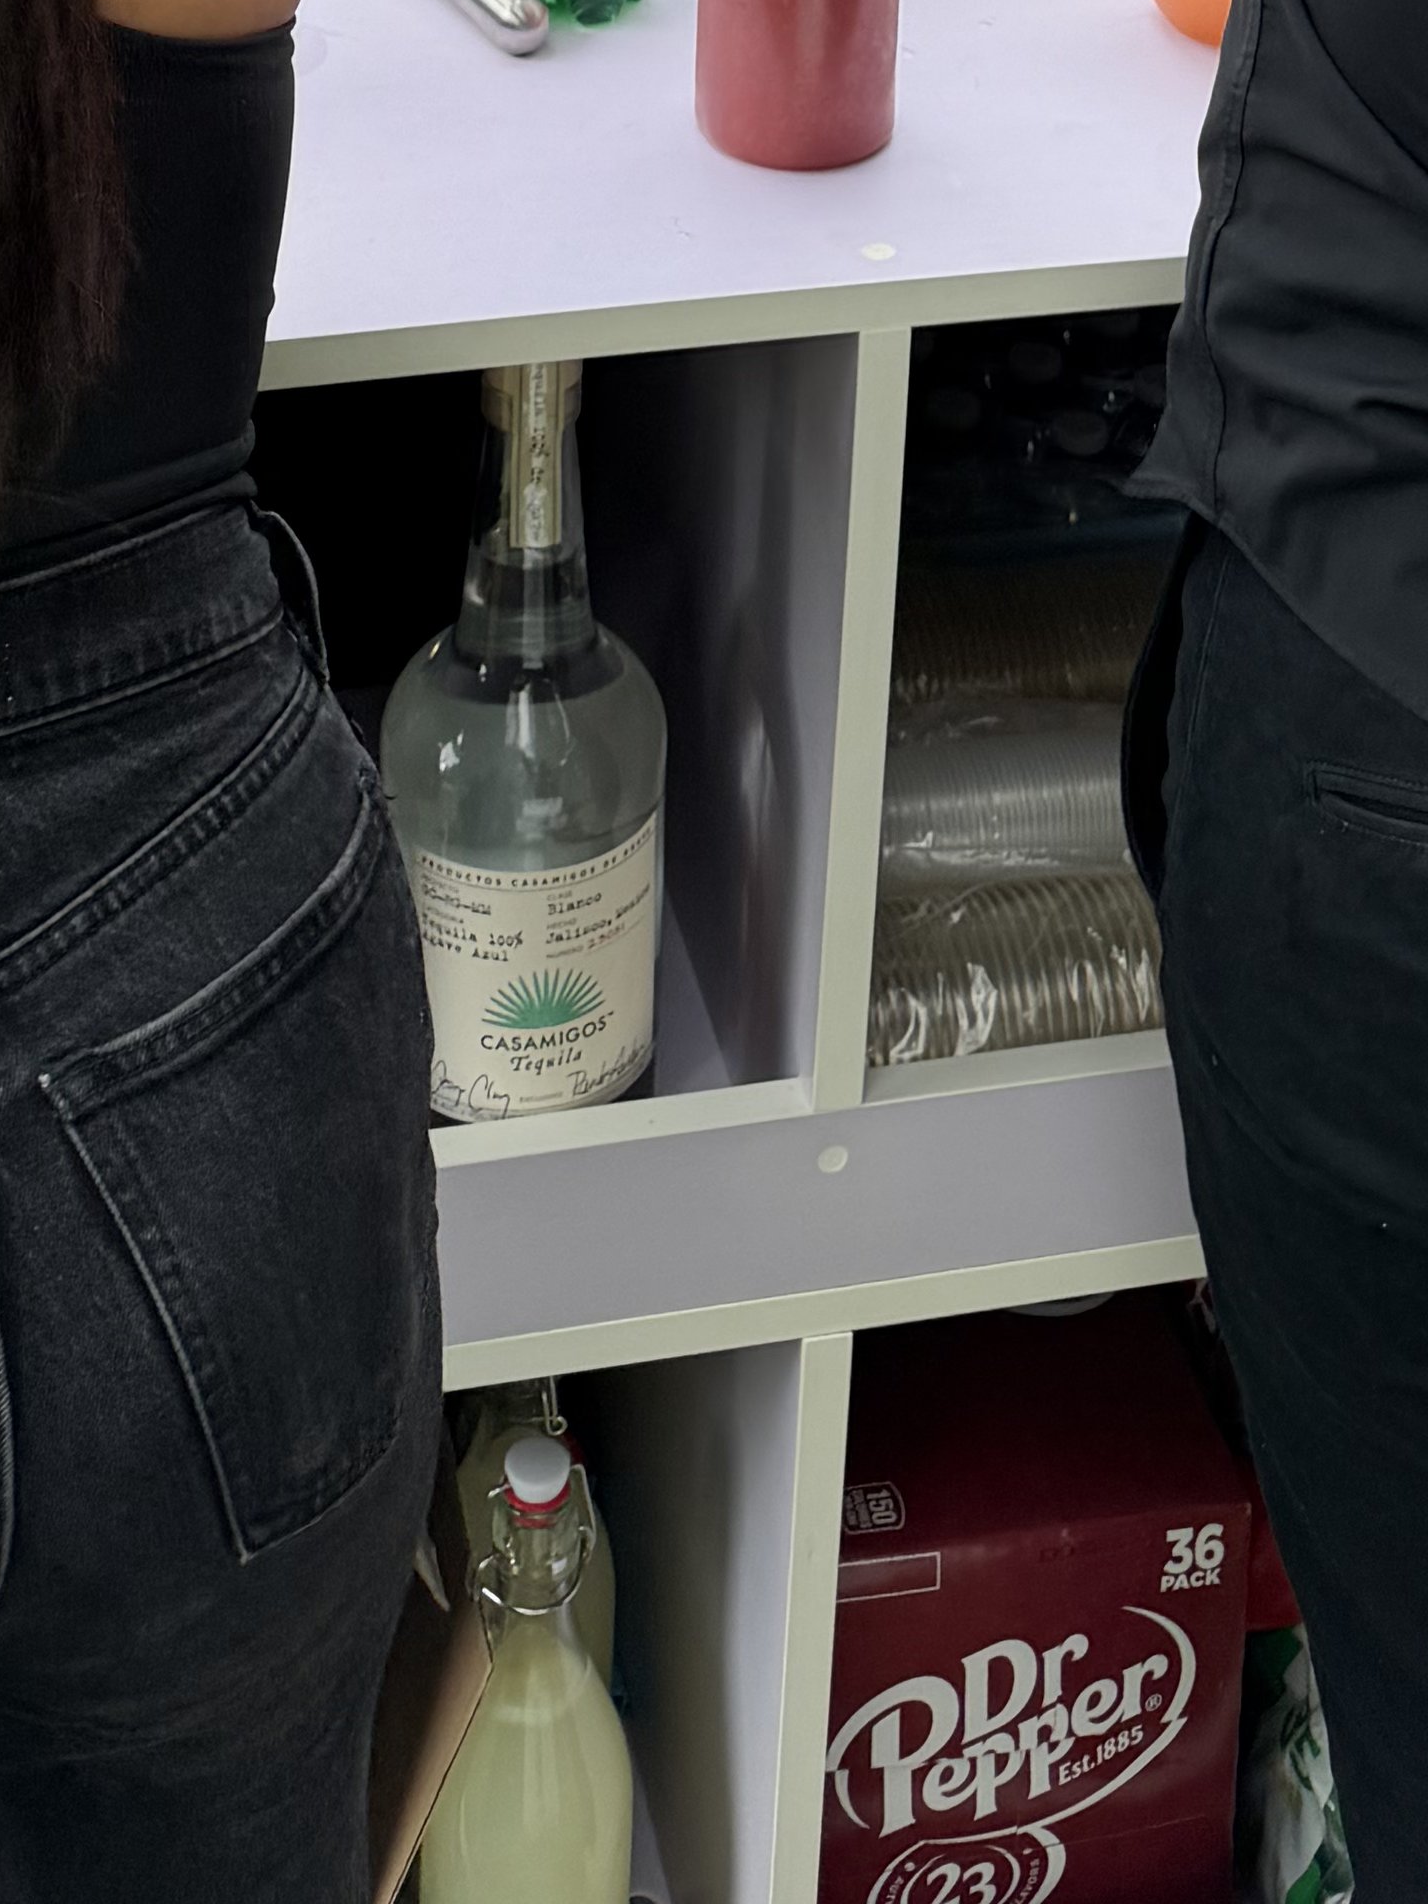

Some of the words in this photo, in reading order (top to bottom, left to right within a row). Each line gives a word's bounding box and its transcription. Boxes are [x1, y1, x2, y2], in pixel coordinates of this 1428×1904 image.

[422, 855, 502, 887] PRODUCTOS
[511, 866, 596, 888] CASAMIGOS
[547, 892, 603, 916] Blanco
[471, 947, 509, 962] Azul
[480, 1016, 607, 1052] CASAMIGOS
[510, 1047, 582, 1076] Tequila
[866, 1488, 898, 1526] 150
[1163, 1523, 1225, 1573] 36
[1160, 1568, 1221, 1593] PACK
[961, 1633, 1089, 1745] Dr
[826, 1654, 1169, 1839] Pepper
[926, 1861, 998, 1904] 23
